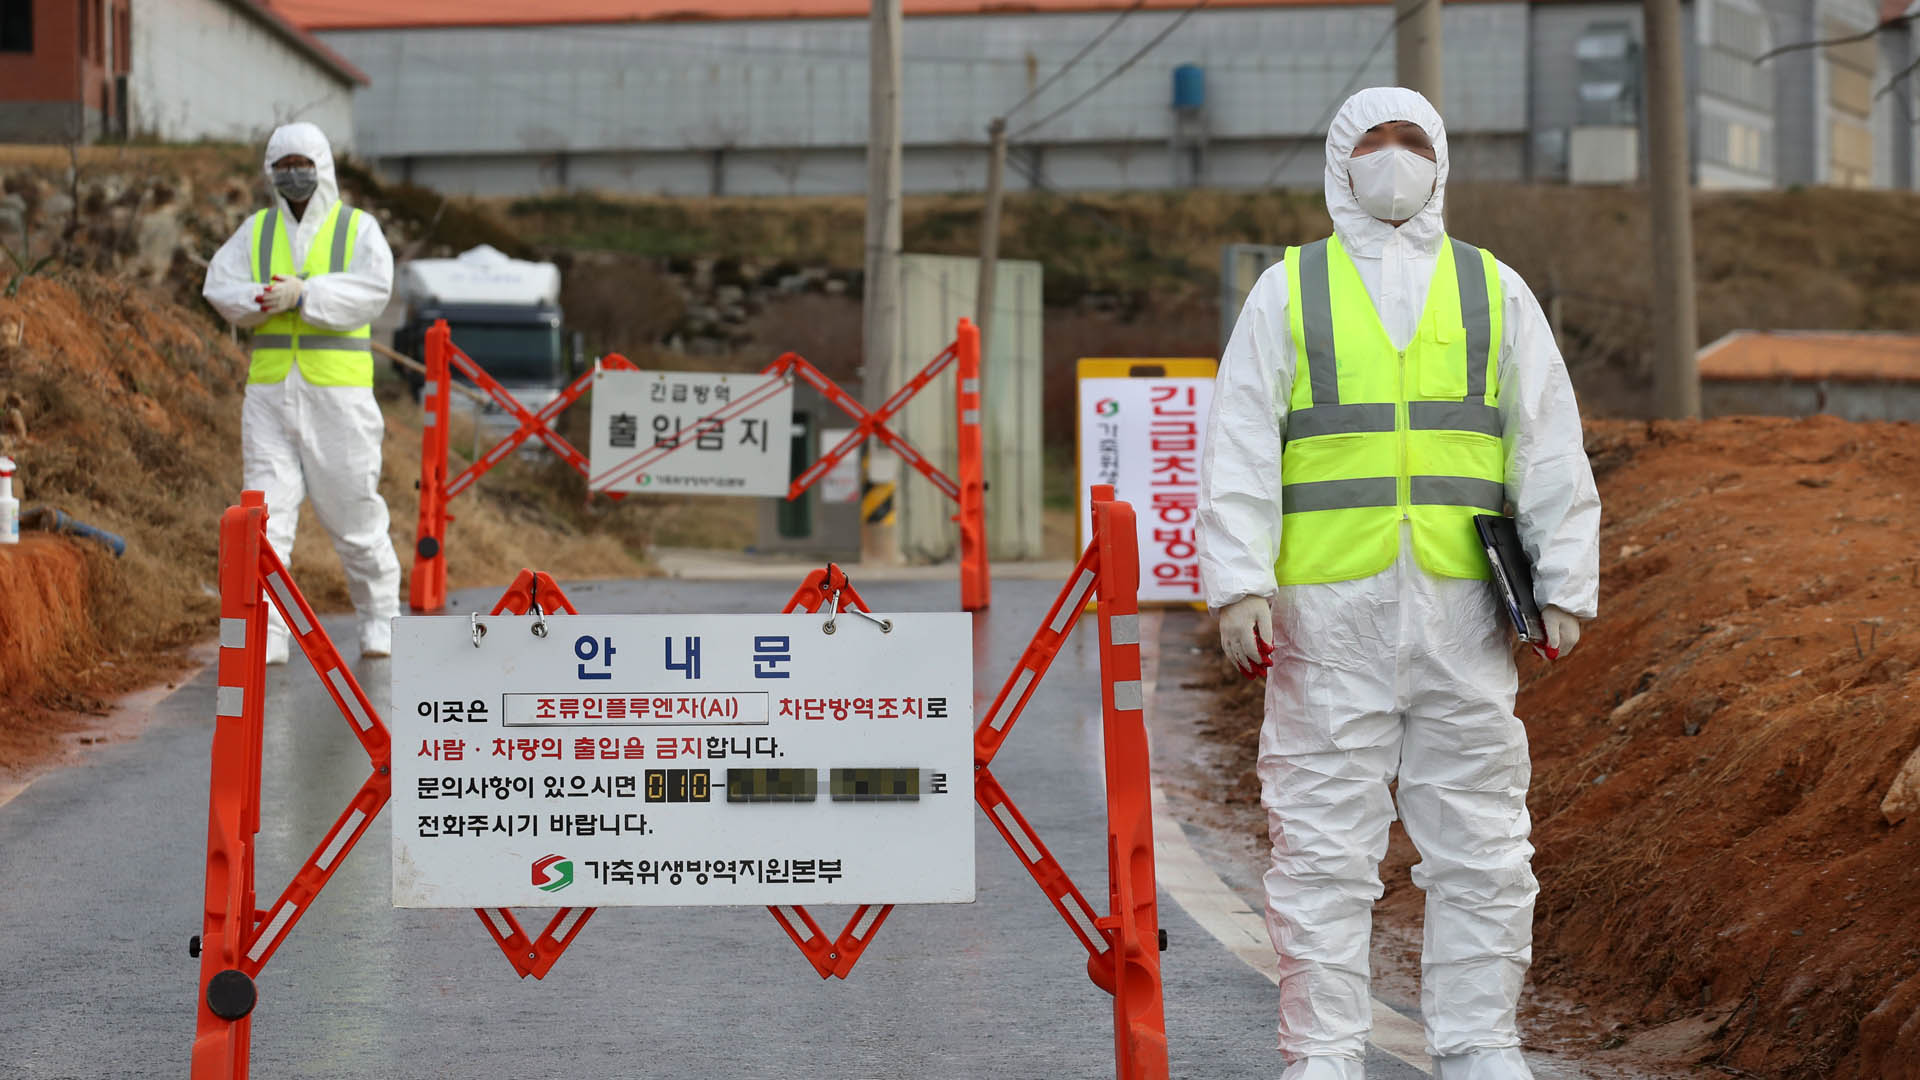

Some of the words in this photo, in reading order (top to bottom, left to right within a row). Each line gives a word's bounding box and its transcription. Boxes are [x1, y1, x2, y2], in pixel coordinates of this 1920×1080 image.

[1149, 386, 1200, 594] 긴급초동방역
[417, 699, 489, 723] 이곳은
[535, 696, 739, 720] 조류인플루엔자(AI)
[778, 696, 948, 722] 차단방역조치로
[491, 737, 563, 762] 차량의
[574, 736, 645, 760] 출입을
[655, 736, 784, 760] 금지합니다.
[417, 776, 534, 800] 문의사항이
[543, 775, 636, 799] 있으시면
[417, 814, 538, 838] 전화주시기
[549, 813, 654, 837] 바랍니다.
[584, 858, 843, 886] 가축위생방역지원본부
